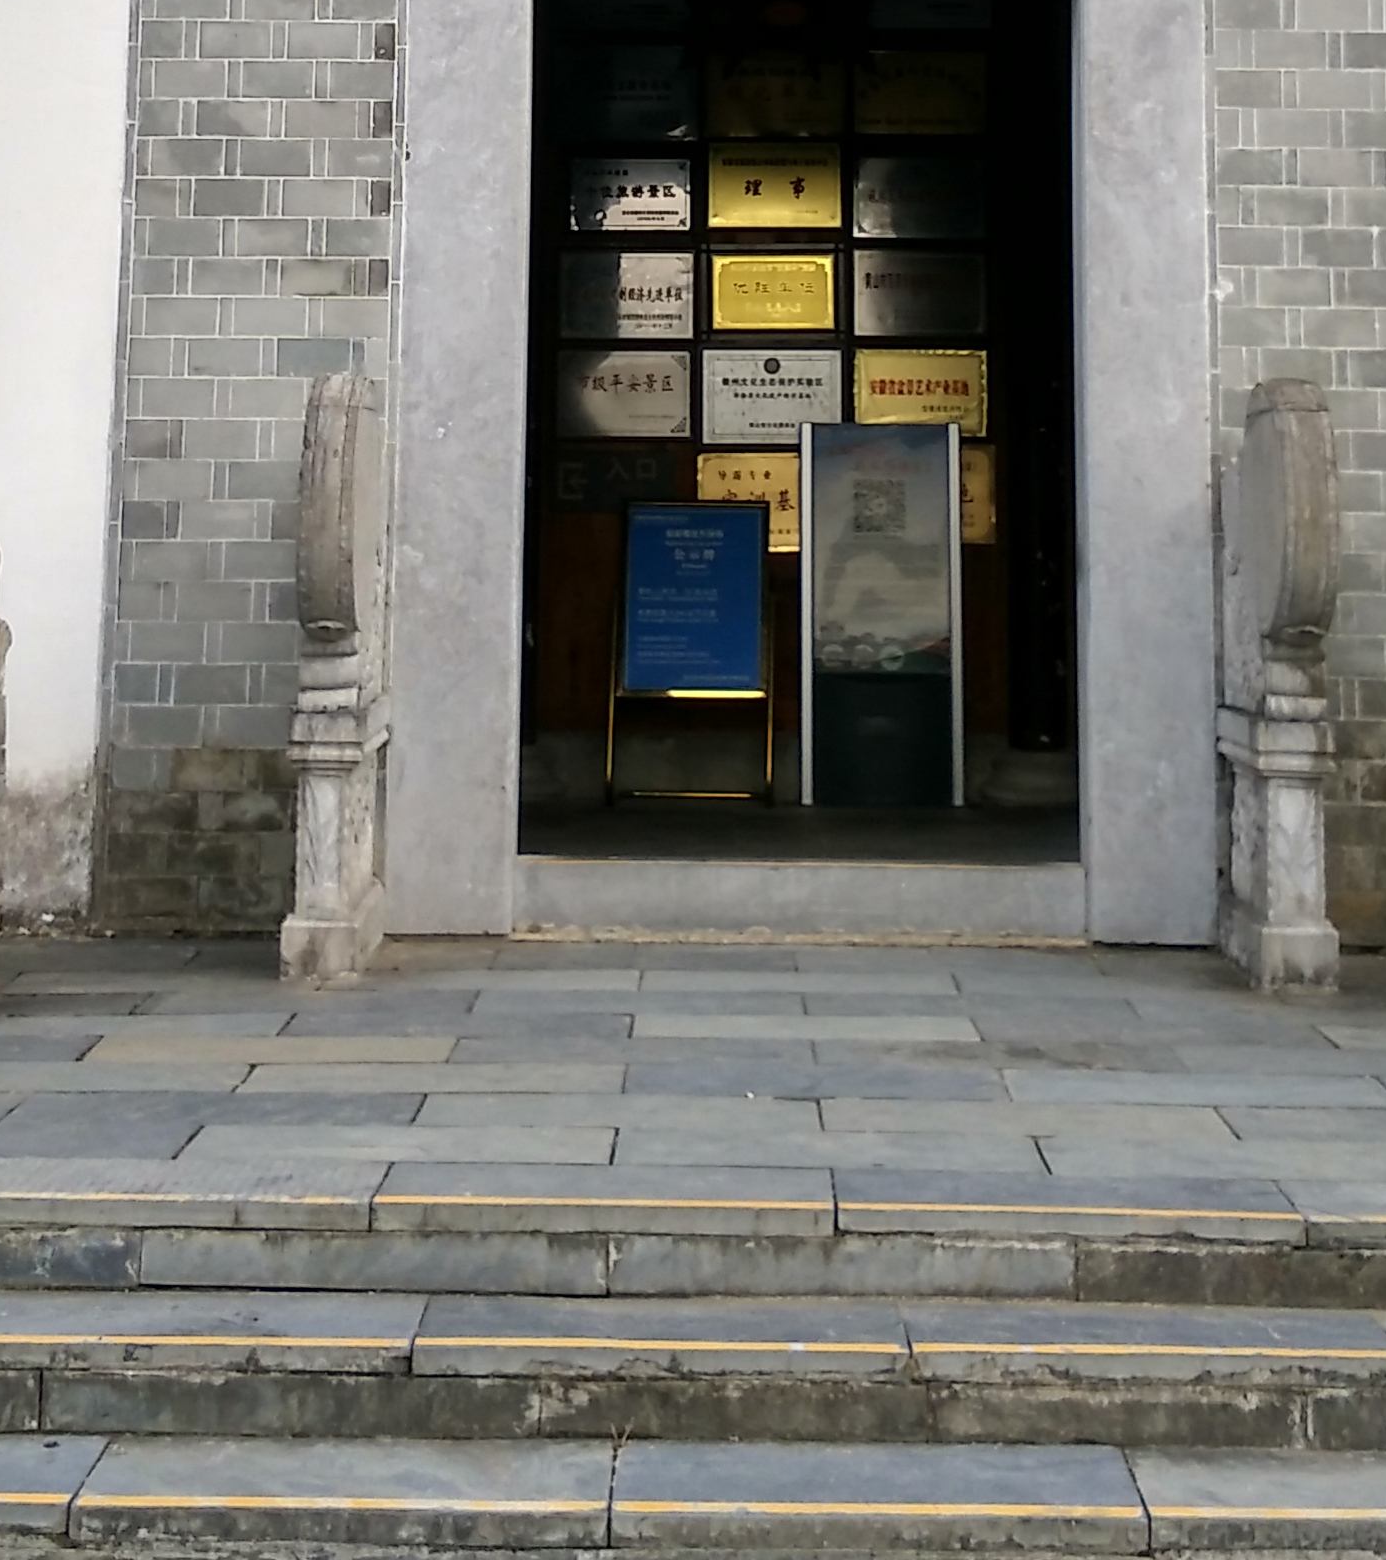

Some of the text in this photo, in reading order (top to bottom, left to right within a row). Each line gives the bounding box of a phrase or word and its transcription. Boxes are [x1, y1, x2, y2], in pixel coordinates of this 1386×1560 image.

[574, 373, 674, 395] 市级平安景区
[605, 456, 658, 481] 入口
